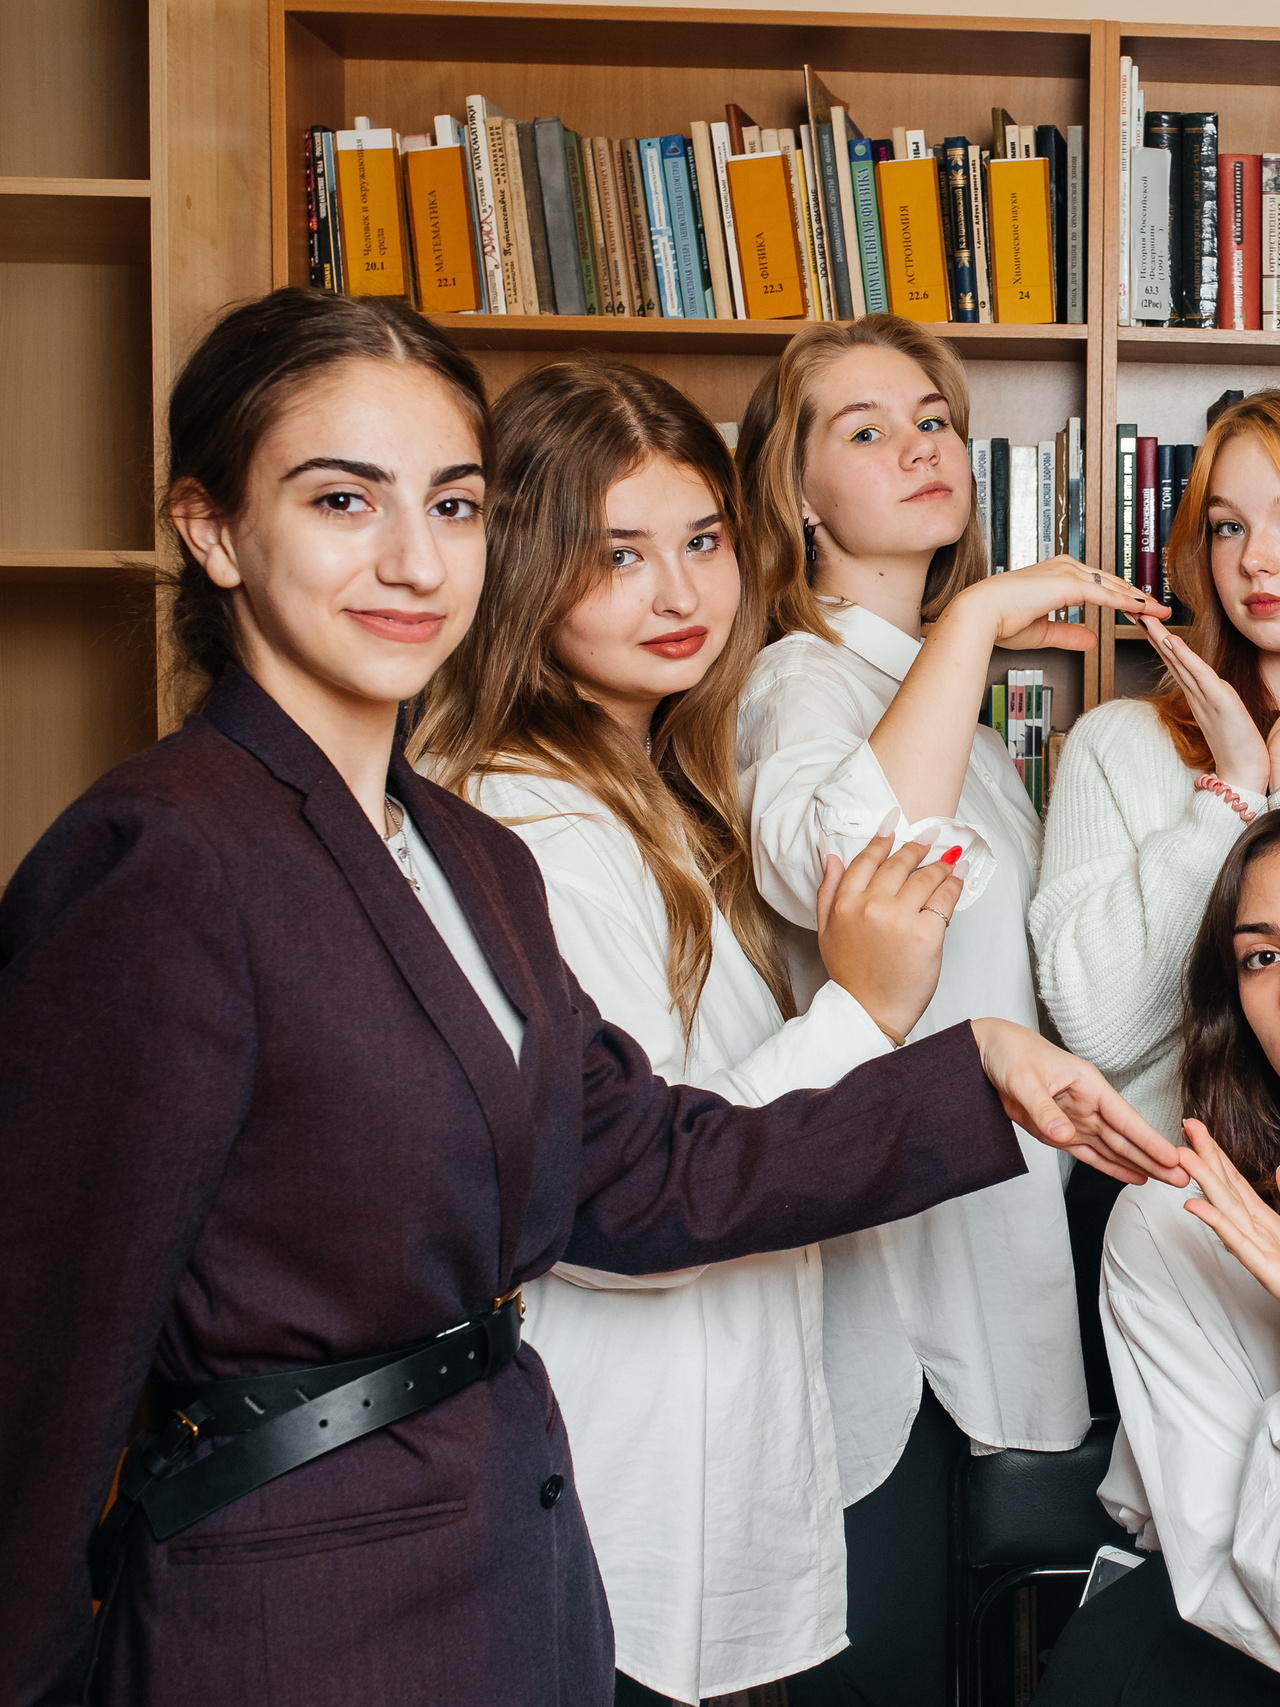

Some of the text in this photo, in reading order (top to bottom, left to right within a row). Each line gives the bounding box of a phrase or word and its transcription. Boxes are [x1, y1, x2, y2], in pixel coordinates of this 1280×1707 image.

[467, 105, 482, 172] МАТЕМАТИКИ
[822, 134, 832, 163] ФИЗИКЕ
[355, 138, 369, 203] окружающая
[826, 166, 833, 175] ПО
[478, 176, 487, 207] СТРАНЕ
[721, 179, 730, 219] СТРАНИЦАМИ
[811, 189, 821, 224] ФИЗИКЕ
[361, 215, 372, 256] Человек
[428, 190, 443, 273] МАТЕМАТИКА
[498, 189, 513, 257] Путешествие
[816, 227, 823, 240] ПО
[830, 206, 843, 263] ЗАНИМАТЕЛЬНЫЕ
[1010, 192, 1022, 285] Химические науки
[1139, 176, 1148, 279] История Российской
[376, 228, 387, 255] среда
[754, 231, 770, 280] ФИЗИКА
[857, 167, 884, 312] АНИМАТЕЛЬНАЯ ФИЗИКА
[899, 205, 916, 286] АСТРОНОМИЯ
[365, 261, 384, 272] 20.1
[820, 263, 828, 279] 100
[437, 278, 456, 288] 22.1
[763, 283, 784, 294] 22.3
[909, 291, 929, 301] 22.6
[1019, 291, 1030, 300] 24
[1145, 286, 1159, 295] 63.3
[1141, 299, 1162, 310] (2Рос)
[978, 450, 987, 505] МЕСЯЦЕВ ЗДОРОВЬЯ
[1042, 452, 1051, 481] ЗДОРОВЬЯ
[1042, 482, 1051, 507] МЕСЯЦЕВ
[1162, 487, 1171, 510] ТОМ
[1043, 508, 1051, 542] ДВЕНАДЦАТЬ
[1141, 488, 1150, 535] Ключевский
